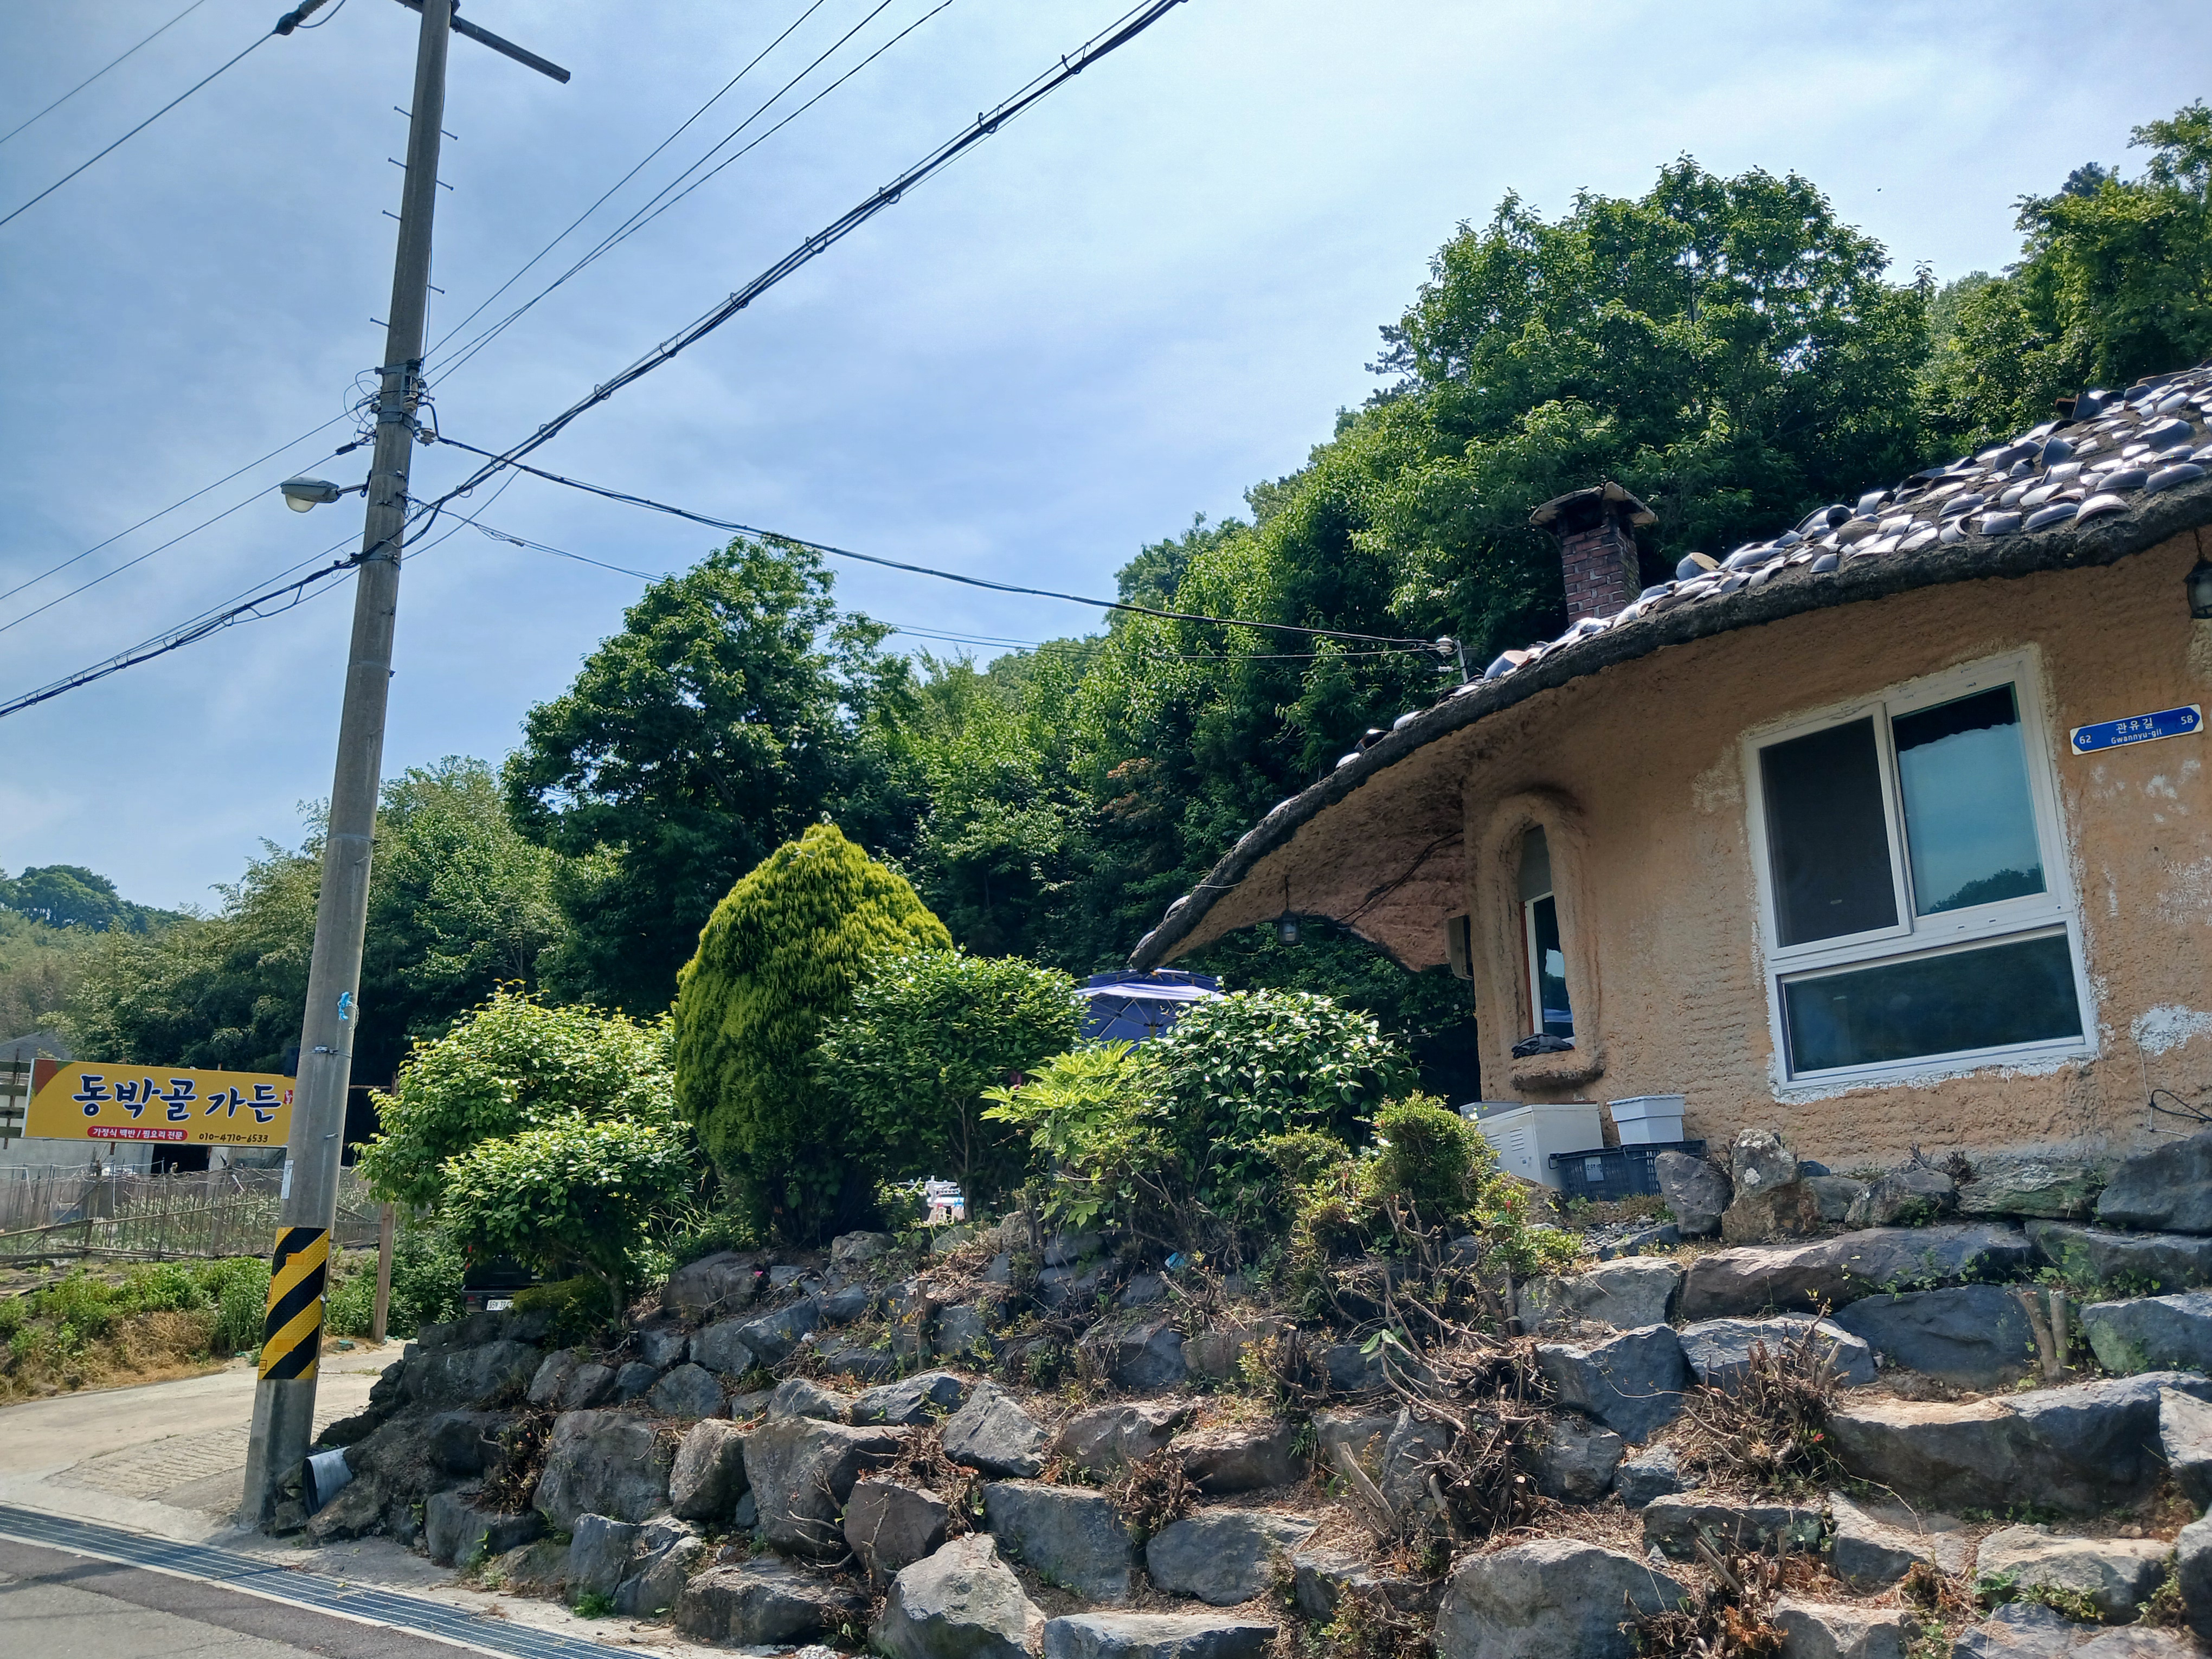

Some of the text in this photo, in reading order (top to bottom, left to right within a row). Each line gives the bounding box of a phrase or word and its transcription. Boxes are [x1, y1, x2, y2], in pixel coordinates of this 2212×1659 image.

[2115, 717, 2154, 734] 관유길
[2181, 715, 2194, 725] 58
[2079, 735, 2092, 744] 62
[2111, 728, 2163, 744] Gwannyu-gil
[72, 1074, 282, 1124] 동박골 가든
[92, 1127, 118, 1137] 가정식
[168, 1130, 183, 1140] 전문
[198, 1132, 269, 1143] 010-4710-6533
